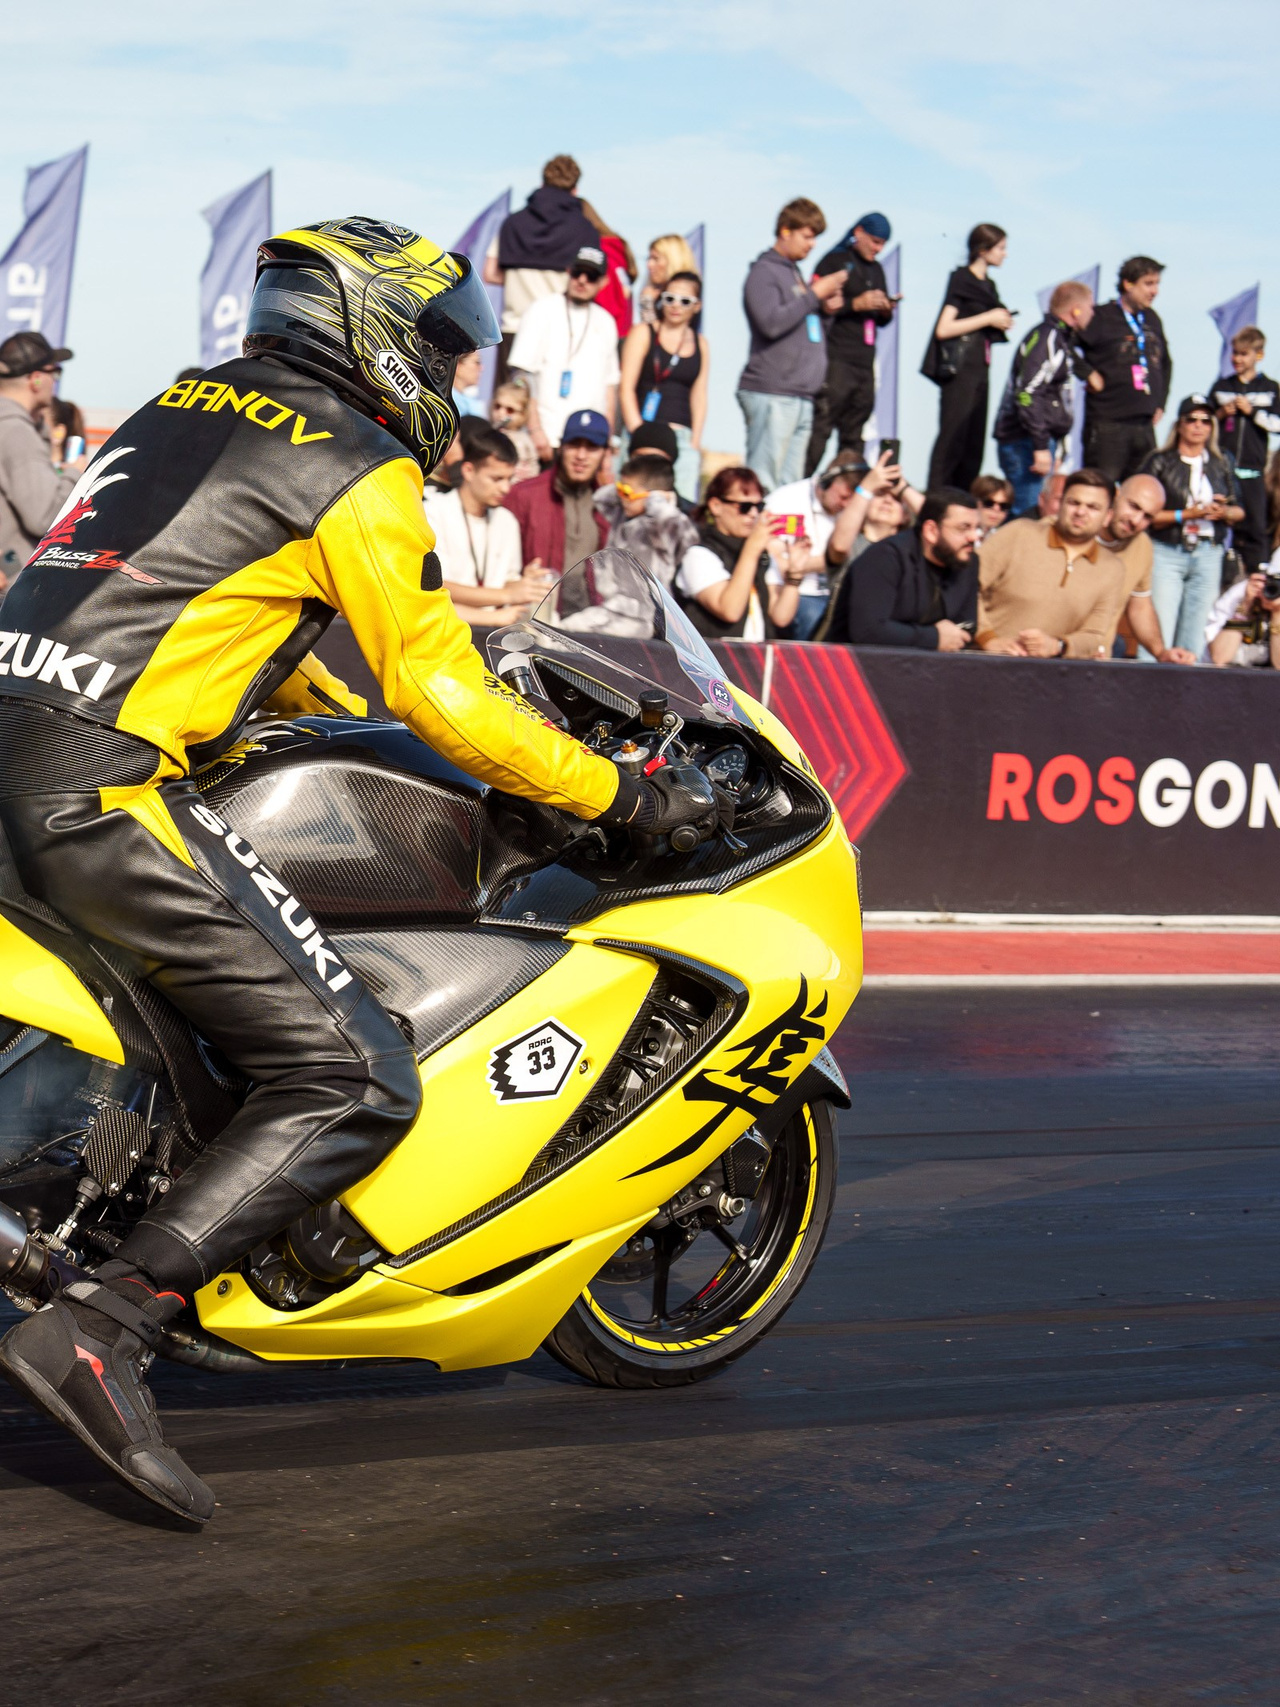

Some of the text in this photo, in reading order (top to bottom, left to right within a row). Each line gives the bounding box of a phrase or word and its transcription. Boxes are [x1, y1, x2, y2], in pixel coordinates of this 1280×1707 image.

[381, 355, 417, 398] SHOEI
[189, 804, 354, 993] SUZUKI
[527, 1045, 556, 1075] 33
[528, 1036, 552, 1050] RDRC
